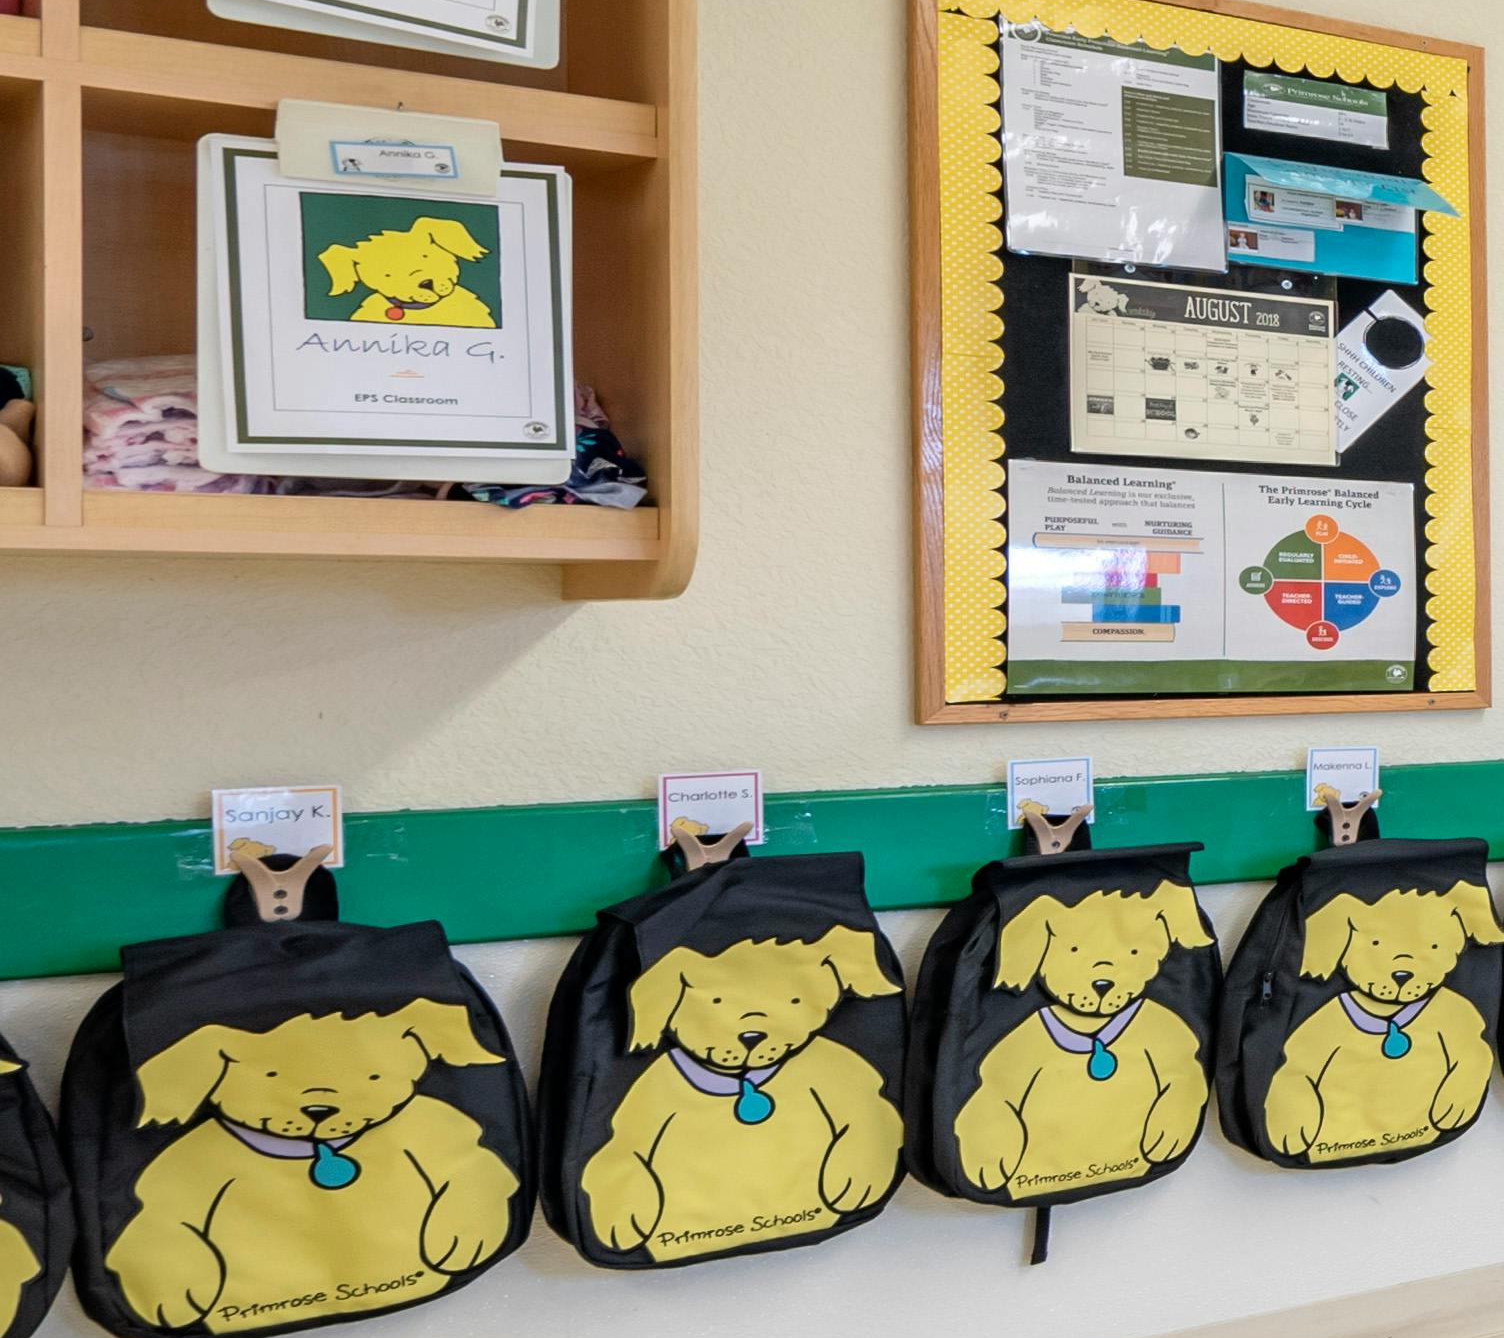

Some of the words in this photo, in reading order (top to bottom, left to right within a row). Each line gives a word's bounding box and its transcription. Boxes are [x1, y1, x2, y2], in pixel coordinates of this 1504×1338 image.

[379, 148, 422, 160] Annika
[1184, 296, 1252, 324] AUGUST
[1256, 311, 1280, 327] 2018
[296, 332, 450, 359] Annika
[466, 341, 505, 365] G.
[1359, 360, 1397, 394] CHILDREN
[354, 392, 379, 405] EPS
[382, 393, 459, 407] Classroom
[1067, 474, 1120, 487] Balanced
[1047, 486, 1088, 496] Balanced
[1089, 489, 1127, 499] Learning
[1128, 490, 1136, 499] is
[1258, 484, 1279, 495] The
[1334, 489, 1380, 500] Balanced
[1047, 495, 1097, 506] time-tested
[1098, 498, 1139, 508] approach
[1140, 498, 1158, 508] that
[1159, 500, 1196, 510] balances
[1267, 495, 1294, 507] Early
[1297, 497, 1344, 509] Learning
[1345, 500, 1372, 509] Cycle
[1044, 515, 1100, 526] PURPOSEFUL
[1144, 520, 1193, 529] NURTURING
[1044, 524, 1066, 532] PLAY
[1152, 528, 1193, 537] GUIDANCE
[1313, 761, 1361, 772] Makenna
[1362, 761, 1374, 771] L.
[1014, 773, 1074, 787] Sophiana
[1075, 772, 1087, 783] F.
[668, 789, 738, 803] Charlotte
[740, 789, 754, 800] S.
[225, 805, 305, 824] Sanjay
[311, 805, 331, 819] K.
[1316, 1137, 1377, 1156] Primrose
[1015, 1167, 1083, 1189] Primrose
[659, 1223, 745, 1248] Primrose
[217, 1291, 328, 1323] Primrose
